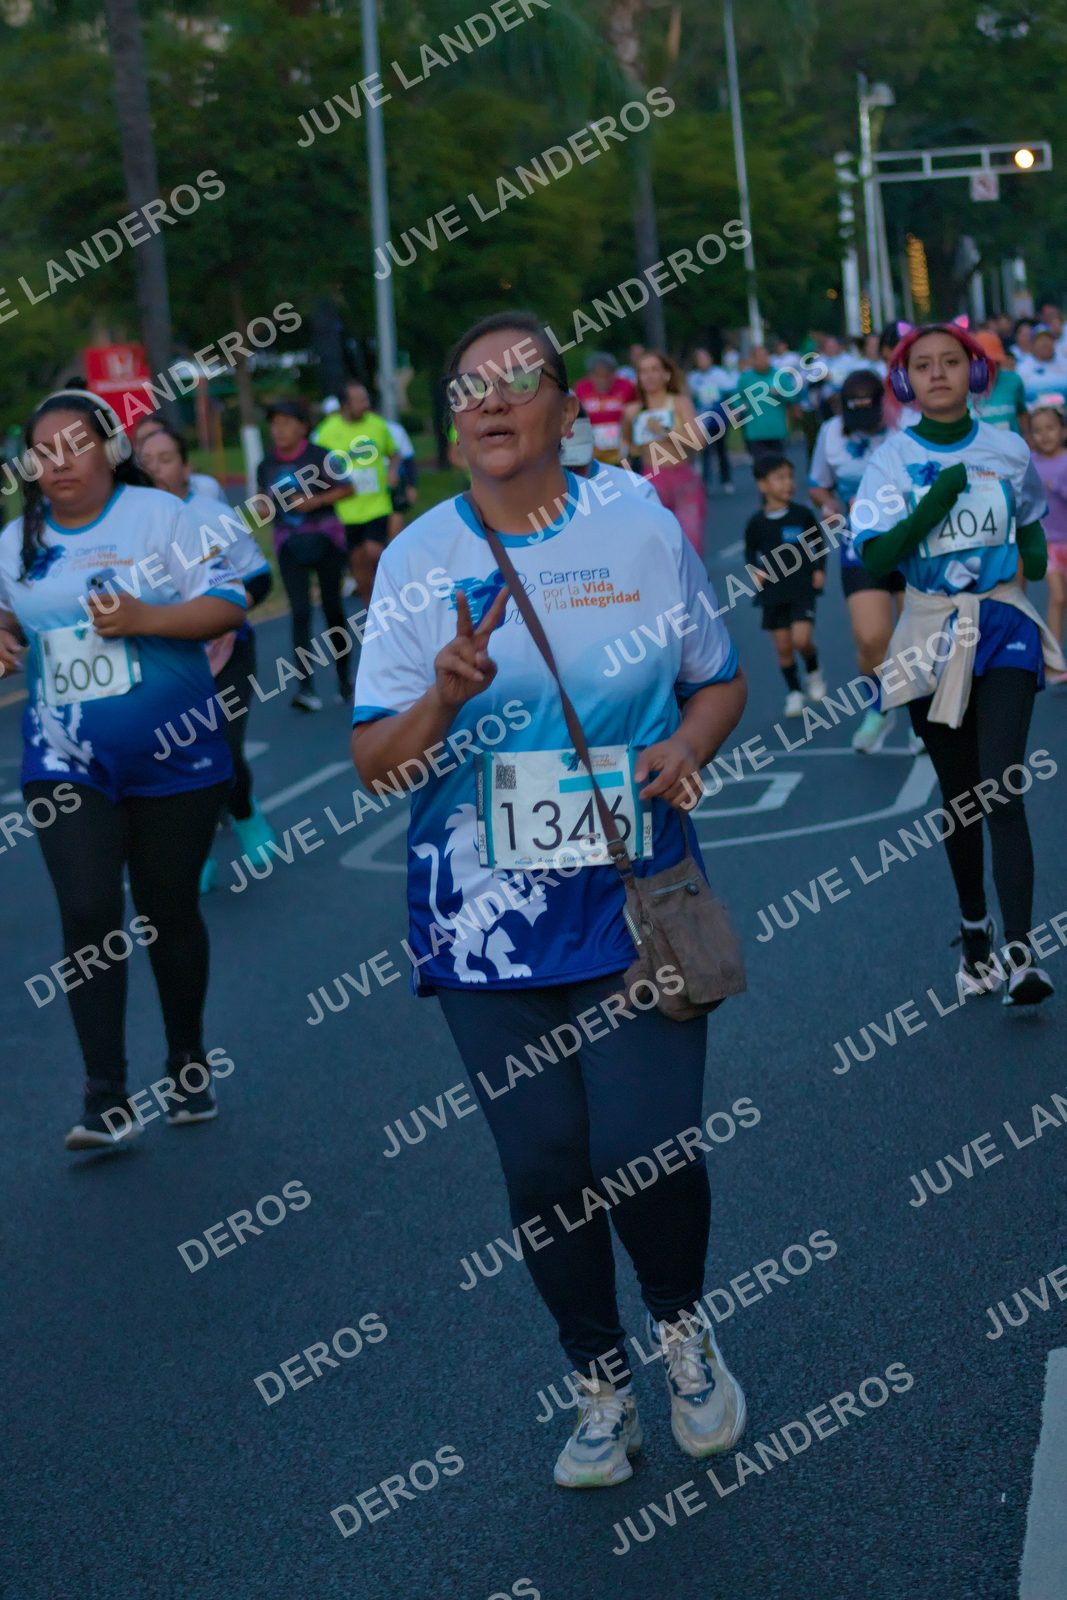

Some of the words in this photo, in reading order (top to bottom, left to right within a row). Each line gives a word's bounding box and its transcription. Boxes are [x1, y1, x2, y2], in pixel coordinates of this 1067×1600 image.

[938, 507, 998, 541] 404
[540, 567, 610, 585] Carrera
[543, 587, 565, 600] por
[568, 583, 580, 596] la
[582, 581, 614, 594] Vida
[544, 602, 552, 615] y
[555, 597, 567, 610] la
[570, 590, 640, 609] Integridad
[54, 654, 114, 695] 600
[500, 794, 632, 851] 1346
